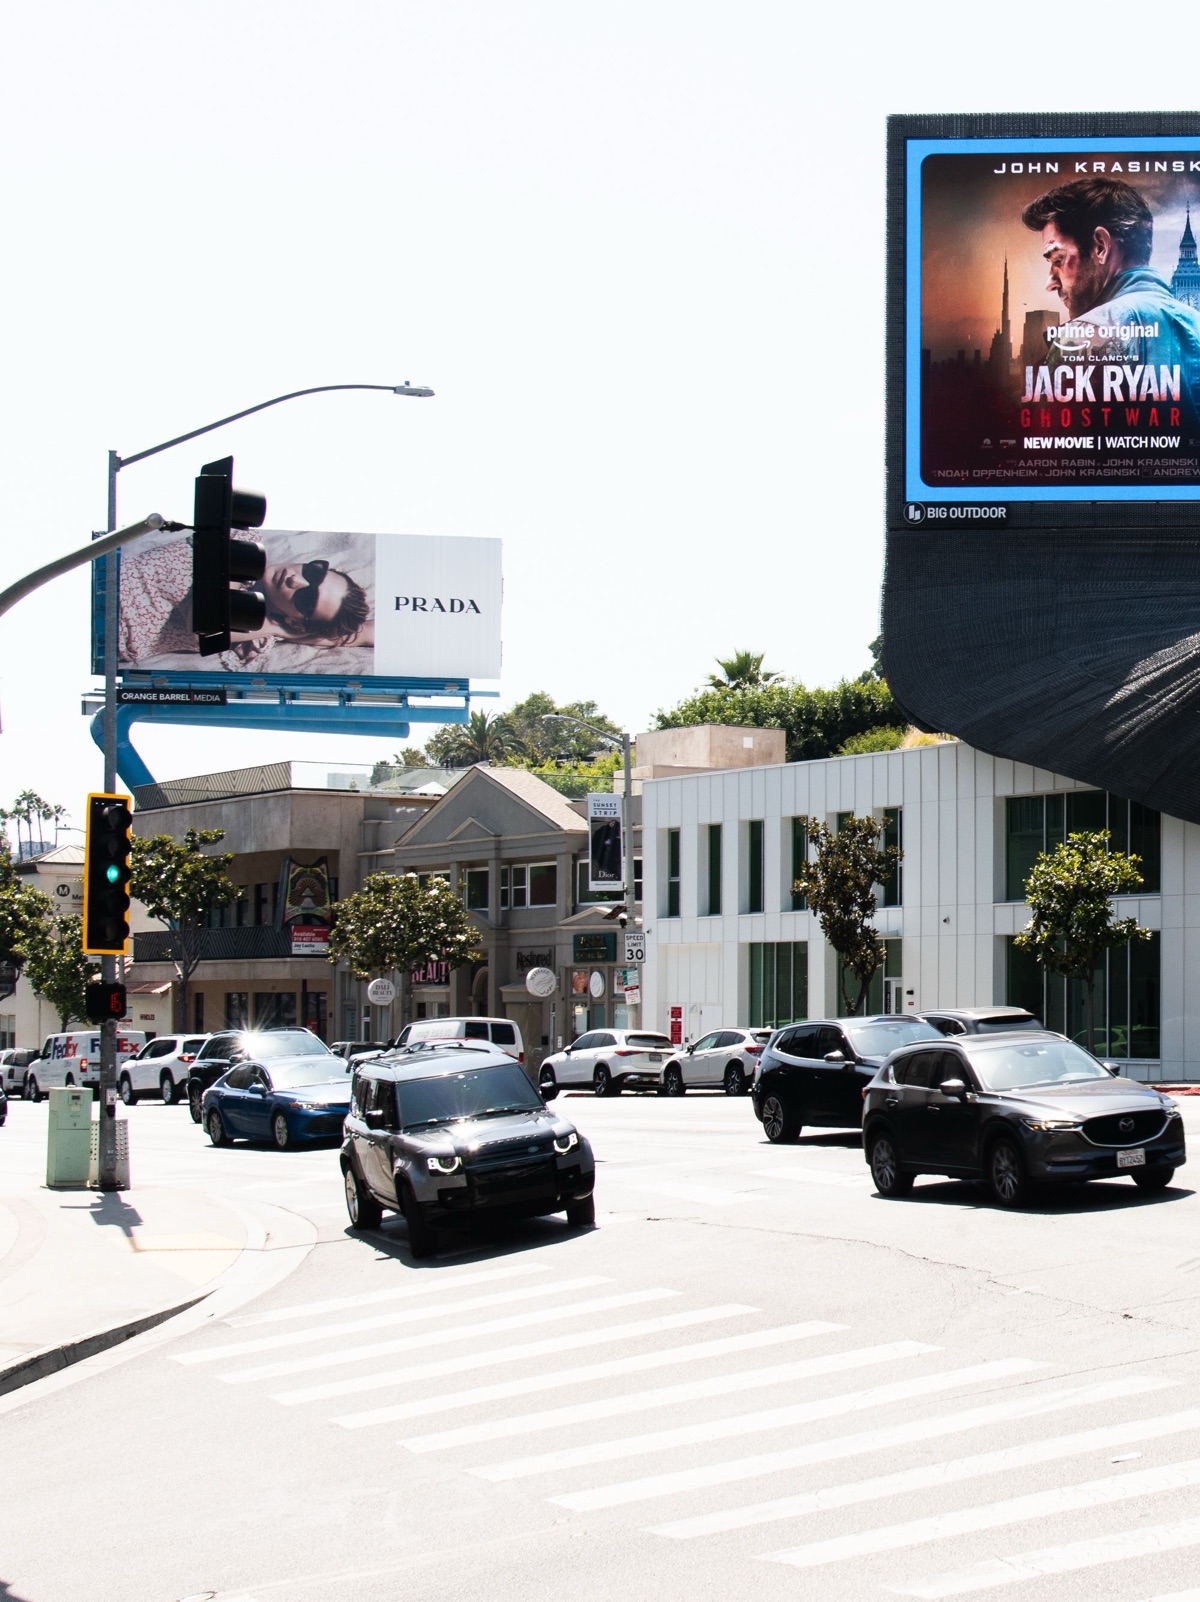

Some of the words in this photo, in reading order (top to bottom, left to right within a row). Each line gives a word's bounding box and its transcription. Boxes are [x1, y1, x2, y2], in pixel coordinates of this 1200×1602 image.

[994, 162, 1059, 174] JOHN
[1046, 322, 1095, 341] prime
[1098, 321, 1159, 341] original
[1088, 354, 1139, 362] CLANCY'S
[1021, 365, 1097, 403] JACK
[1103, 364, 1181, 403] RYAN
[1020, 407, 1111, 428] GHOST
[1125, 407, 1181, 427] WAR
[1023, 437, 1053, 449] NEW
[1054, 437, 1094, 449] MOVIE
[1105, 436, 1148, 449] WATCH
[1150, 436, 1181, 448] NOW
[1018, 459, 1058, 467] AARON
[1061, 459, 1096, 467] RABIN
[1102, 458, 1134, 467] JOHN
[1137, 458, 1199, 466] KRASINSKI
[937, 469, 969, 478] NOAH
[972, 469, 1038, 477] OPPENHEIM
[1044, 469, 1076, 477] JOHN
[1079, 468, 1140, 476] KRASINSKI
[927, 507, 948, 519] BIG
[949, 507, 1007, 519] OUTDOOR
[394, 596, 482, 614] PRADA
[121, 692, 158, 701] ORANGE
[159, 693, 191, 701] BARREL
[193, 694, 221, 702] MEDIA
[598, 870, 615, 878] Dior
[626, 949, 644, 960] 30
[52, 1036, 78, 1060] FedEx
